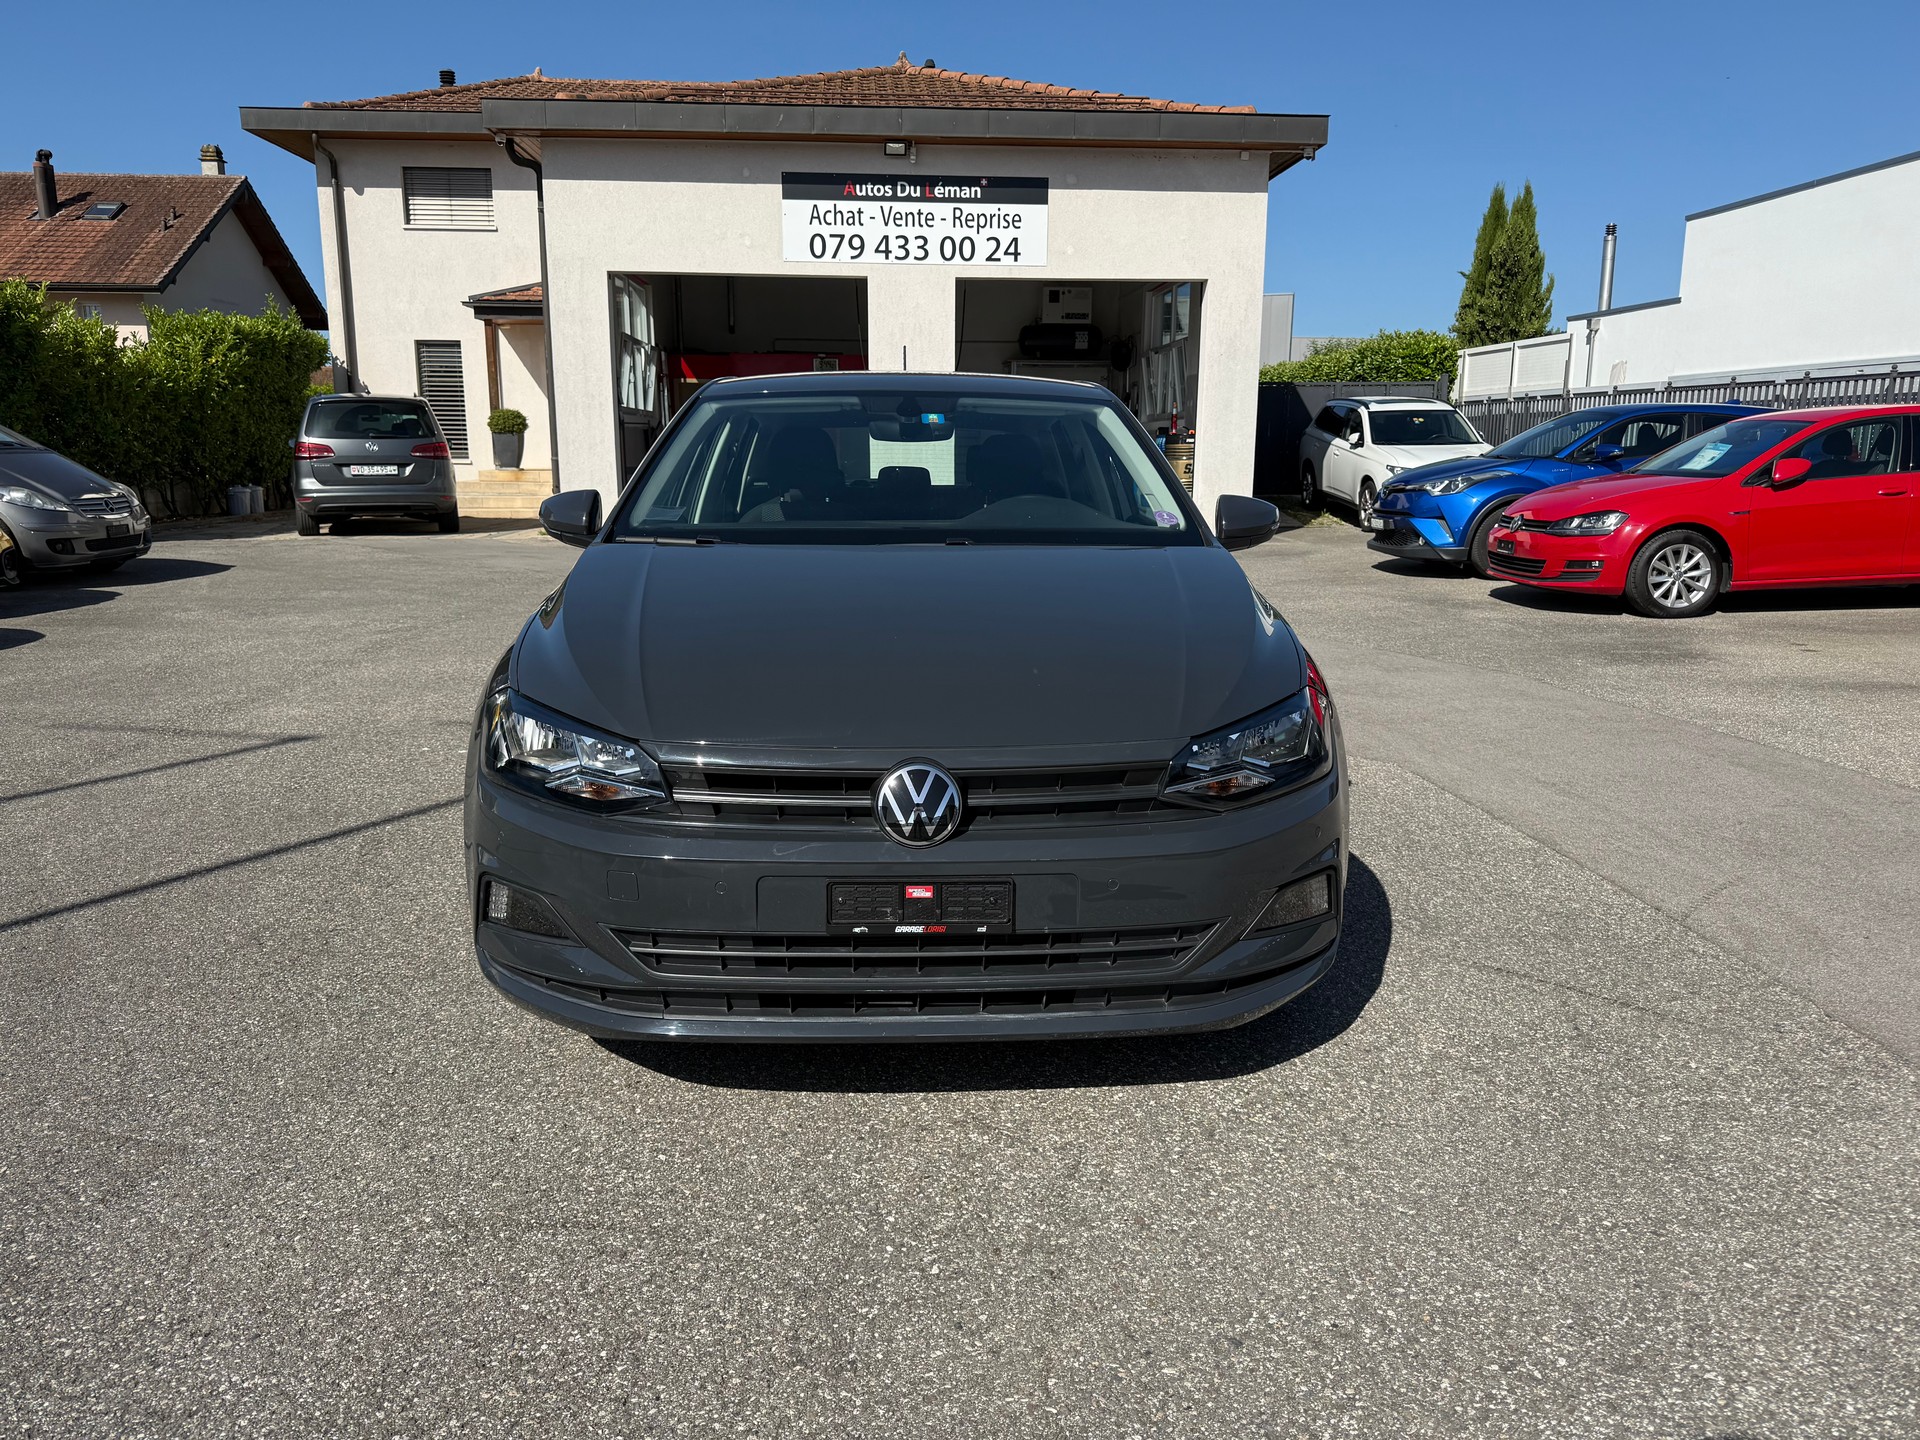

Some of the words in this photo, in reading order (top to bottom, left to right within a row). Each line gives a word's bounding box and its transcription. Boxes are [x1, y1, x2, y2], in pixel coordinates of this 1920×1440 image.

[843, 181, 893, 197] Autos
[897, 181, 920, 197] Du
[925, 182, 981, 198] Léman
[809, 203, 864, 226] Achat
[880, 205, 935, 228] Vente
[953, 207, 1022, 234] Reprise
[809, 233, 865, 259] 079
[874, 235, 929, 261] 433
[940, 236, 976, 262] 00
[985, 236, 1021, 262] 24
